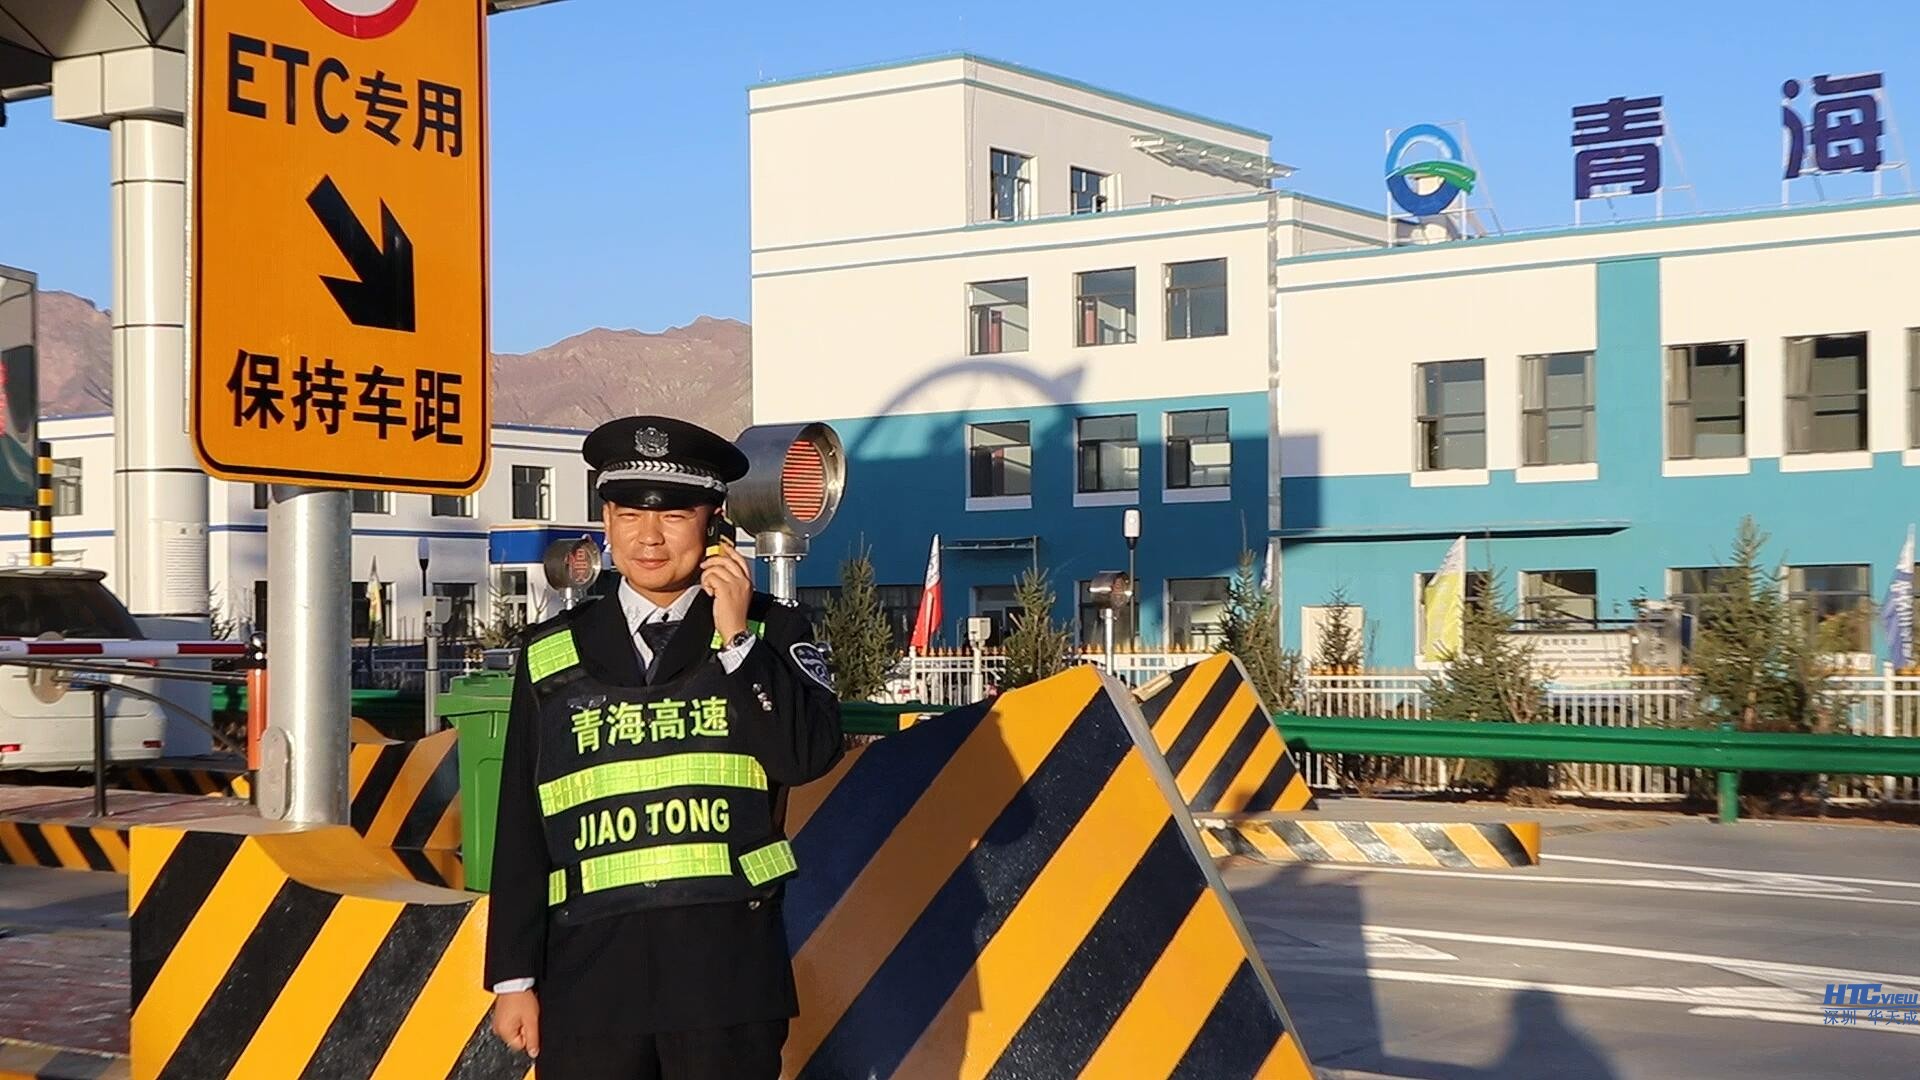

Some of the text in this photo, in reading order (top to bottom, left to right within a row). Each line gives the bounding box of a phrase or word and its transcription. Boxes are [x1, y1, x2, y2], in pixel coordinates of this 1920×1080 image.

[227, 33, 463, 157] ETC专用
[227, 349, 463, 445] 保持车距
[571, 696, 730, 754] 青海高速
[574, 798, 730, 851] JIAO TONG
